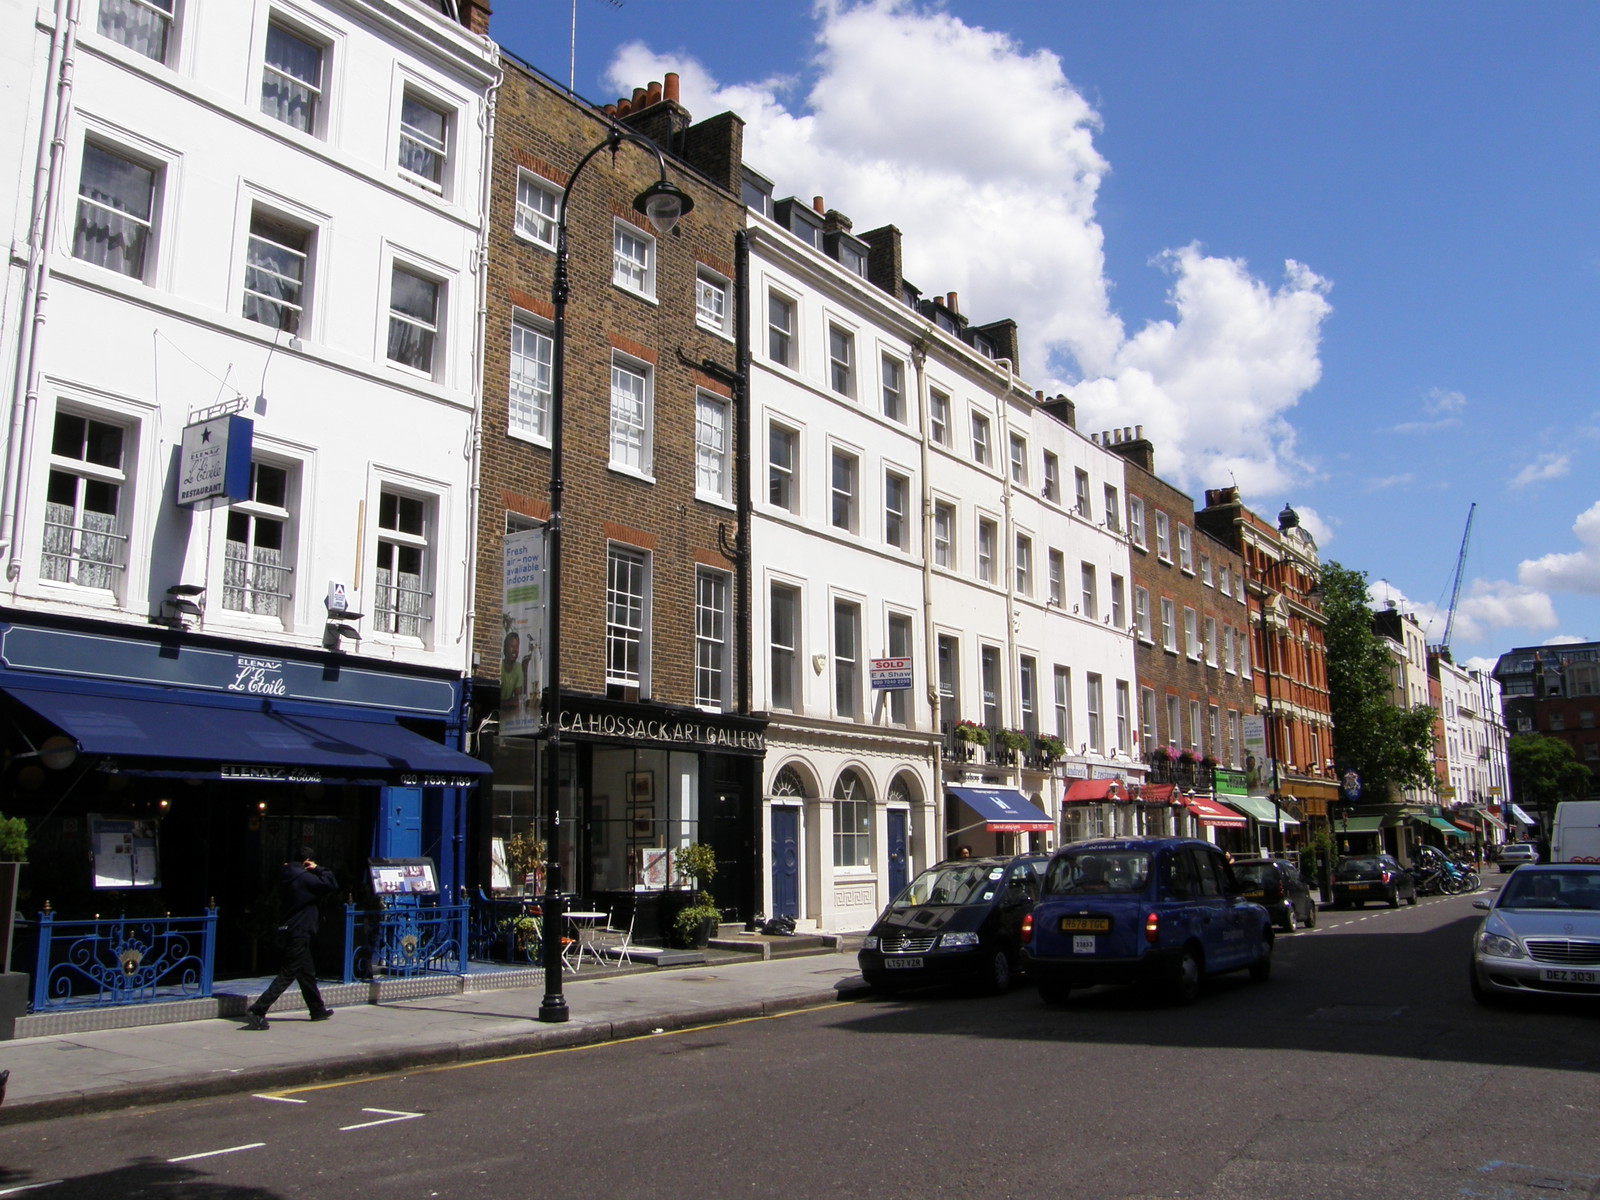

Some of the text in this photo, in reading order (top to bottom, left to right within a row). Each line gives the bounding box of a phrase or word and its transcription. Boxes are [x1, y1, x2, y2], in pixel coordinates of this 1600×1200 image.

[181, 483, 222, 499] RESTAURANT
[506, 545, 528, 557] Fresh
[506, 558, 516, 567] air
[522, 554, 539, 564] now
[506, 563, 540, 576] available
[506, 574, 535, 585] indoors
[237, 658, 283, 669] ELENA'S
[875, 661, 905, 669] SOLD
[589, 712, 670, 741] HOSSACK
[673, 722, 701, 741] ART
[706, 726, 764, 750] GALLERY
[400, 774, 418, 785] 020
[450, 776, 471, 787] 7189
[1546, 970, 1568, 981] DEZ
